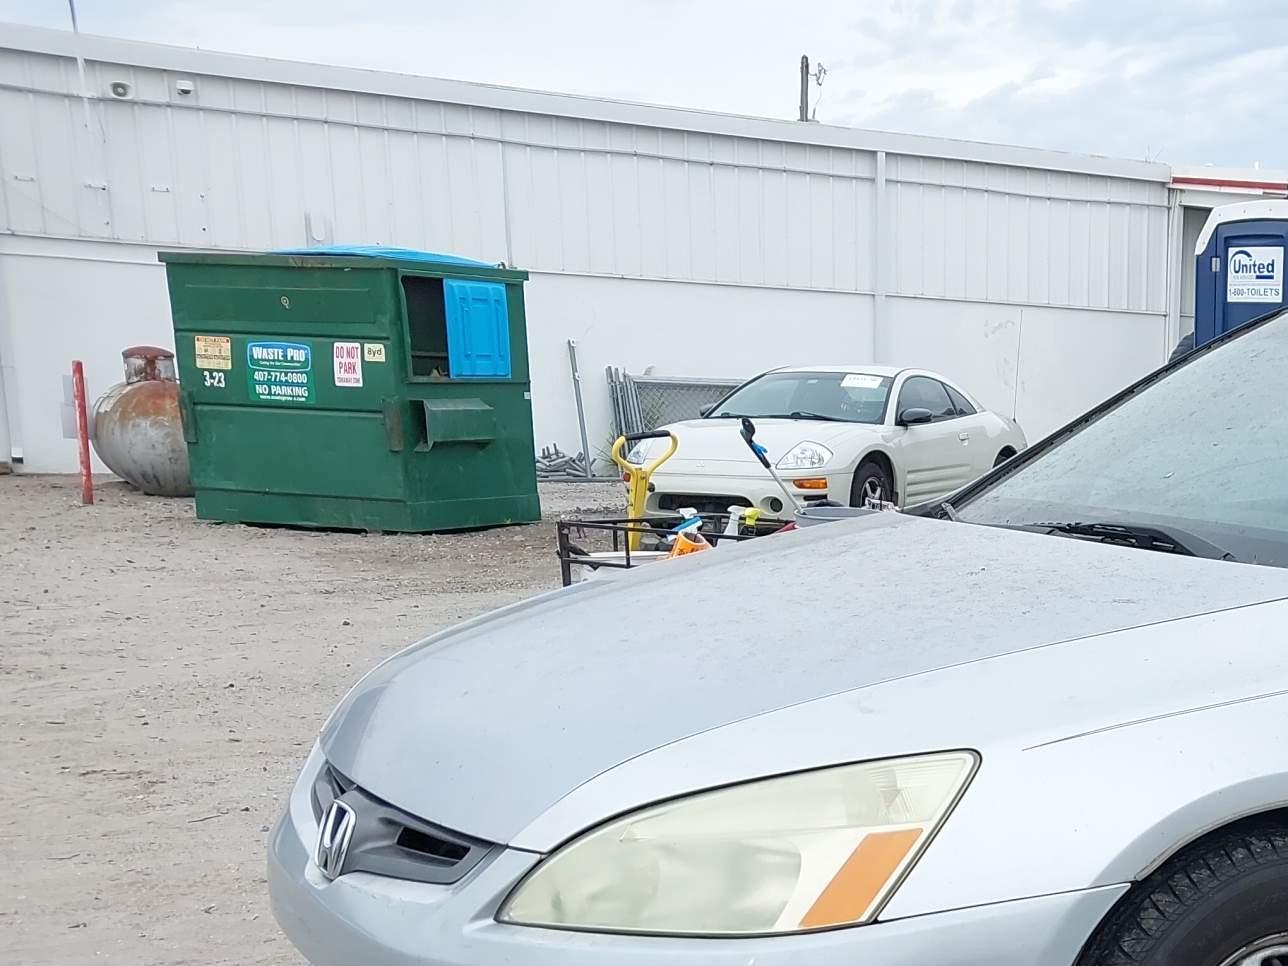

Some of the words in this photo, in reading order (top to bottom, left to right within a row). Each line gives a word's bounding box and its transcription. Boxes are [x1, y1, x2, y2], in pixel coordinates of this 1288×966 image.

[1233, 258, 1274, 274] United
[252, 346, 284, 361] WASTE
[287, 348, 306, 362] PRO
[335, 346, 344, 359] DO
[346, 346, 359, 360] NOT
[338, 361, 358, 375] PARK
[203, 371, 225, 388] 3-23
[255, 384, 269, 395] NO
[270, 384, 309, 397] PARKING
